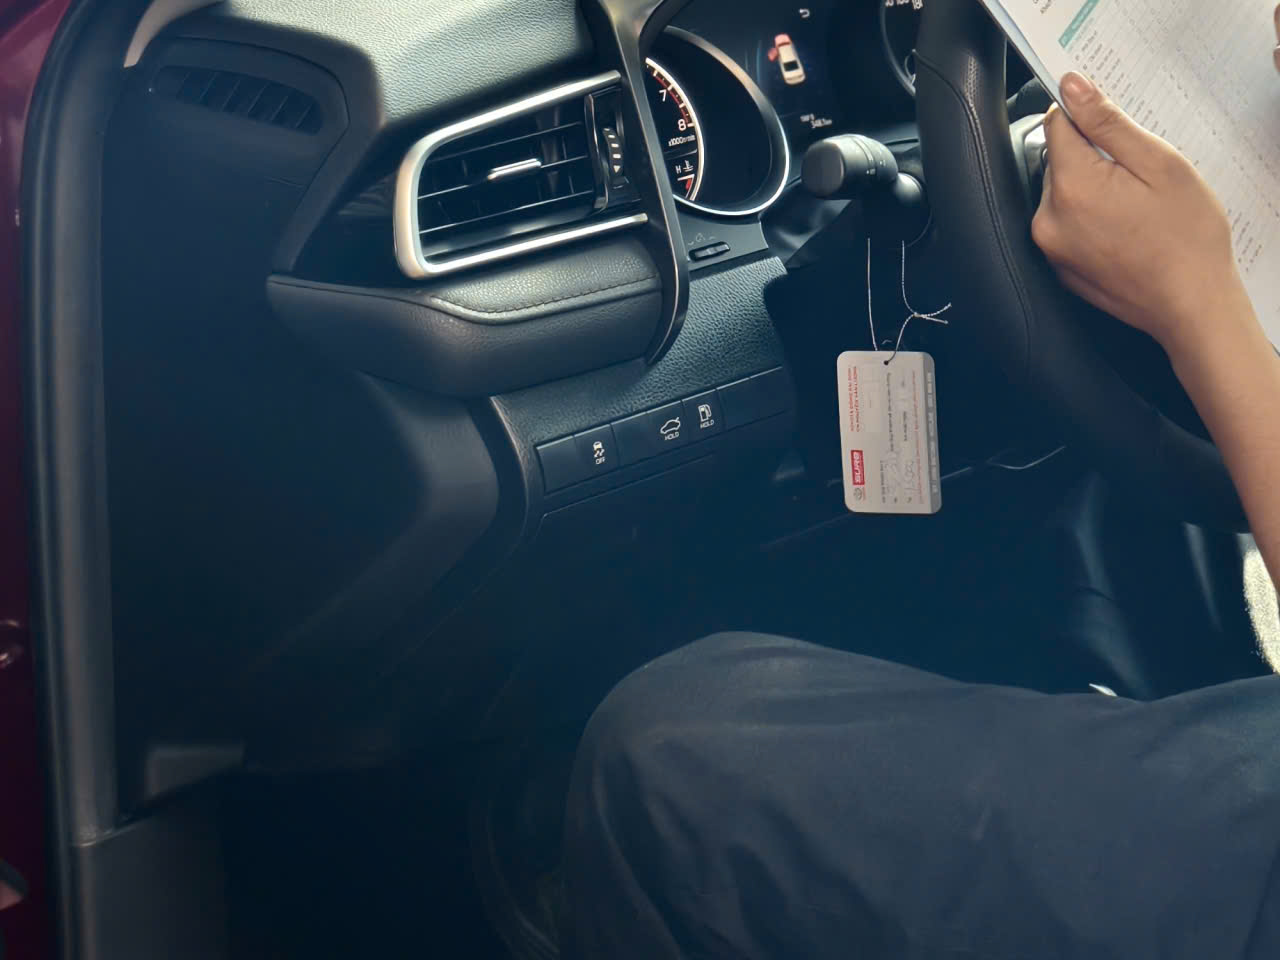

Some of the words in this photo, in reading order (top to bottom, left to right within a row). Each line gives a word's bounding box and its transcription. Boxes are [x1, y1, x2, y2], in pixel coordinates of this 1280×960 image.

[659, 89, 667, 102] 7
[677, 118, 687, 131] 8
[675, 164, 682, 174] H
[700, 419, 715, 429] HOLD
[664, 432, 680, 441] HOLD
[595, 456, 606, 465] OFF
